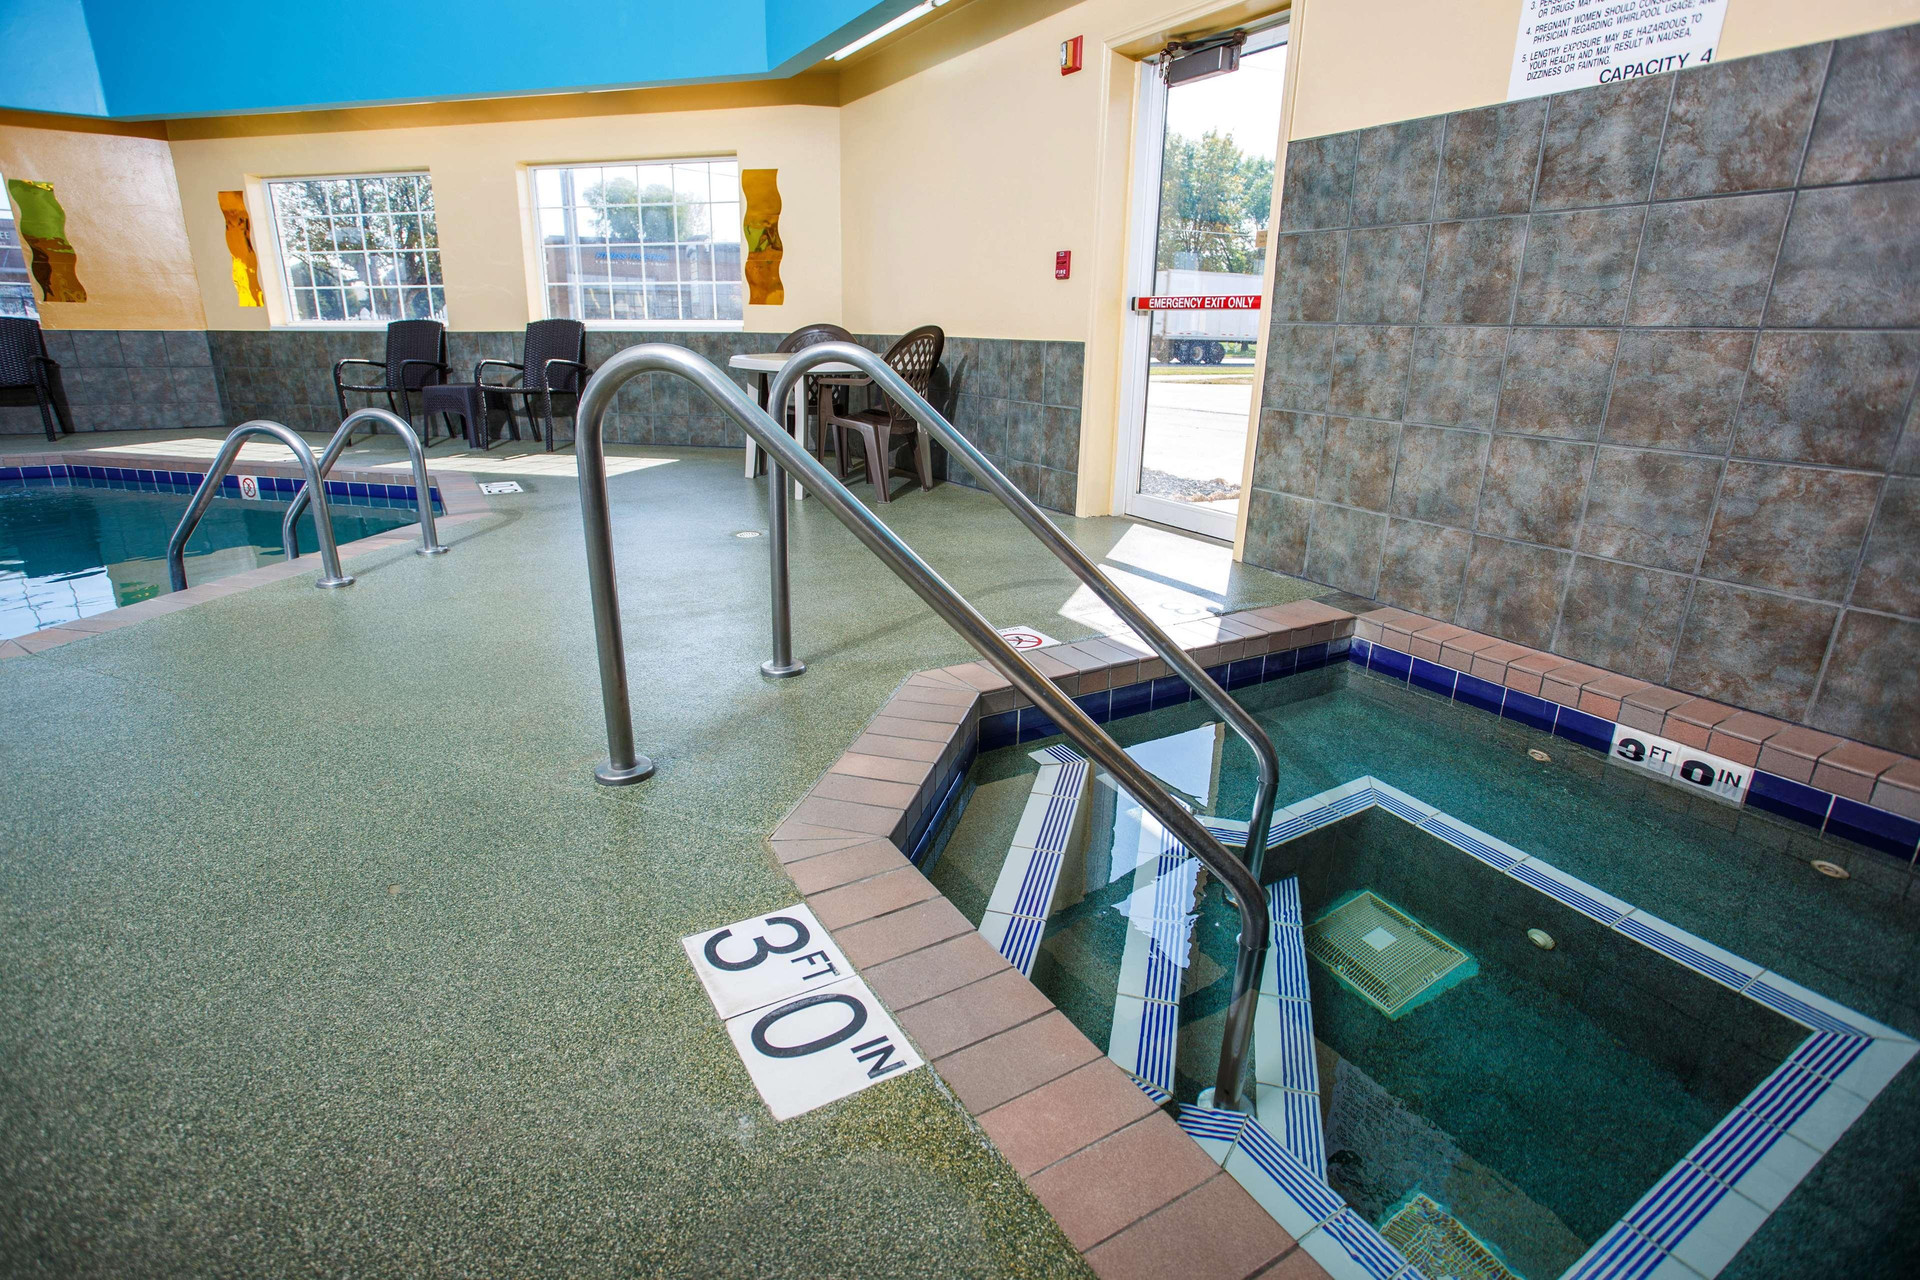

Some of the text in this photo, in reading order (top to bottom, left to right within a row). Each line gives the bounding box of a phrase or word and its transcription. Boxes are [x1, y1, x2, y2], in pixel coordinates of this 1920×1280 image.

[1533, 28, 1569, 44] PHYSICIAN
[1571, 18, 1613, 35] REGARDING
[1616, 7, 1661, 24] WHIRLPOOL
[1535, 17, 1571, 34] PREGNANT
[1574, 10, 1602, 24] WOMEN
[1604, 2, 1635, 17] SHOULD
[1538, 8, 1549, 18] OR
[1550, 1, 1575, 15] DRUGS
[1529, 27, 1692, 70] YOUR HEALTH AND MAY RESULT IN NAUSEA,
[1530, 45, 1561, 61] LENGTHY
[1563, 36, 1602, 53] EXPOSURE
[1604, 32, 1619, 43] MAY
[1622, 29, 1633, 40] BE
[1636, 16, 1687, 36] HAZARDOUS
[1691, 13, 1702, 24] TO
[1526, 55, 1610, 81] DIZZINESS OR FAINTING.
[1599, 47, 1713, 84] CAPACITY 4
[1149, 296, 1255, 309] EMERGENCY EXIT ONLY
[1648, 745, 1672, 762] FT
[1679, 759, 1715, 787] 0
[1717, 768, 1742, 788] IN
[703, 916, 907, 1080] 3 FT 0 IN
